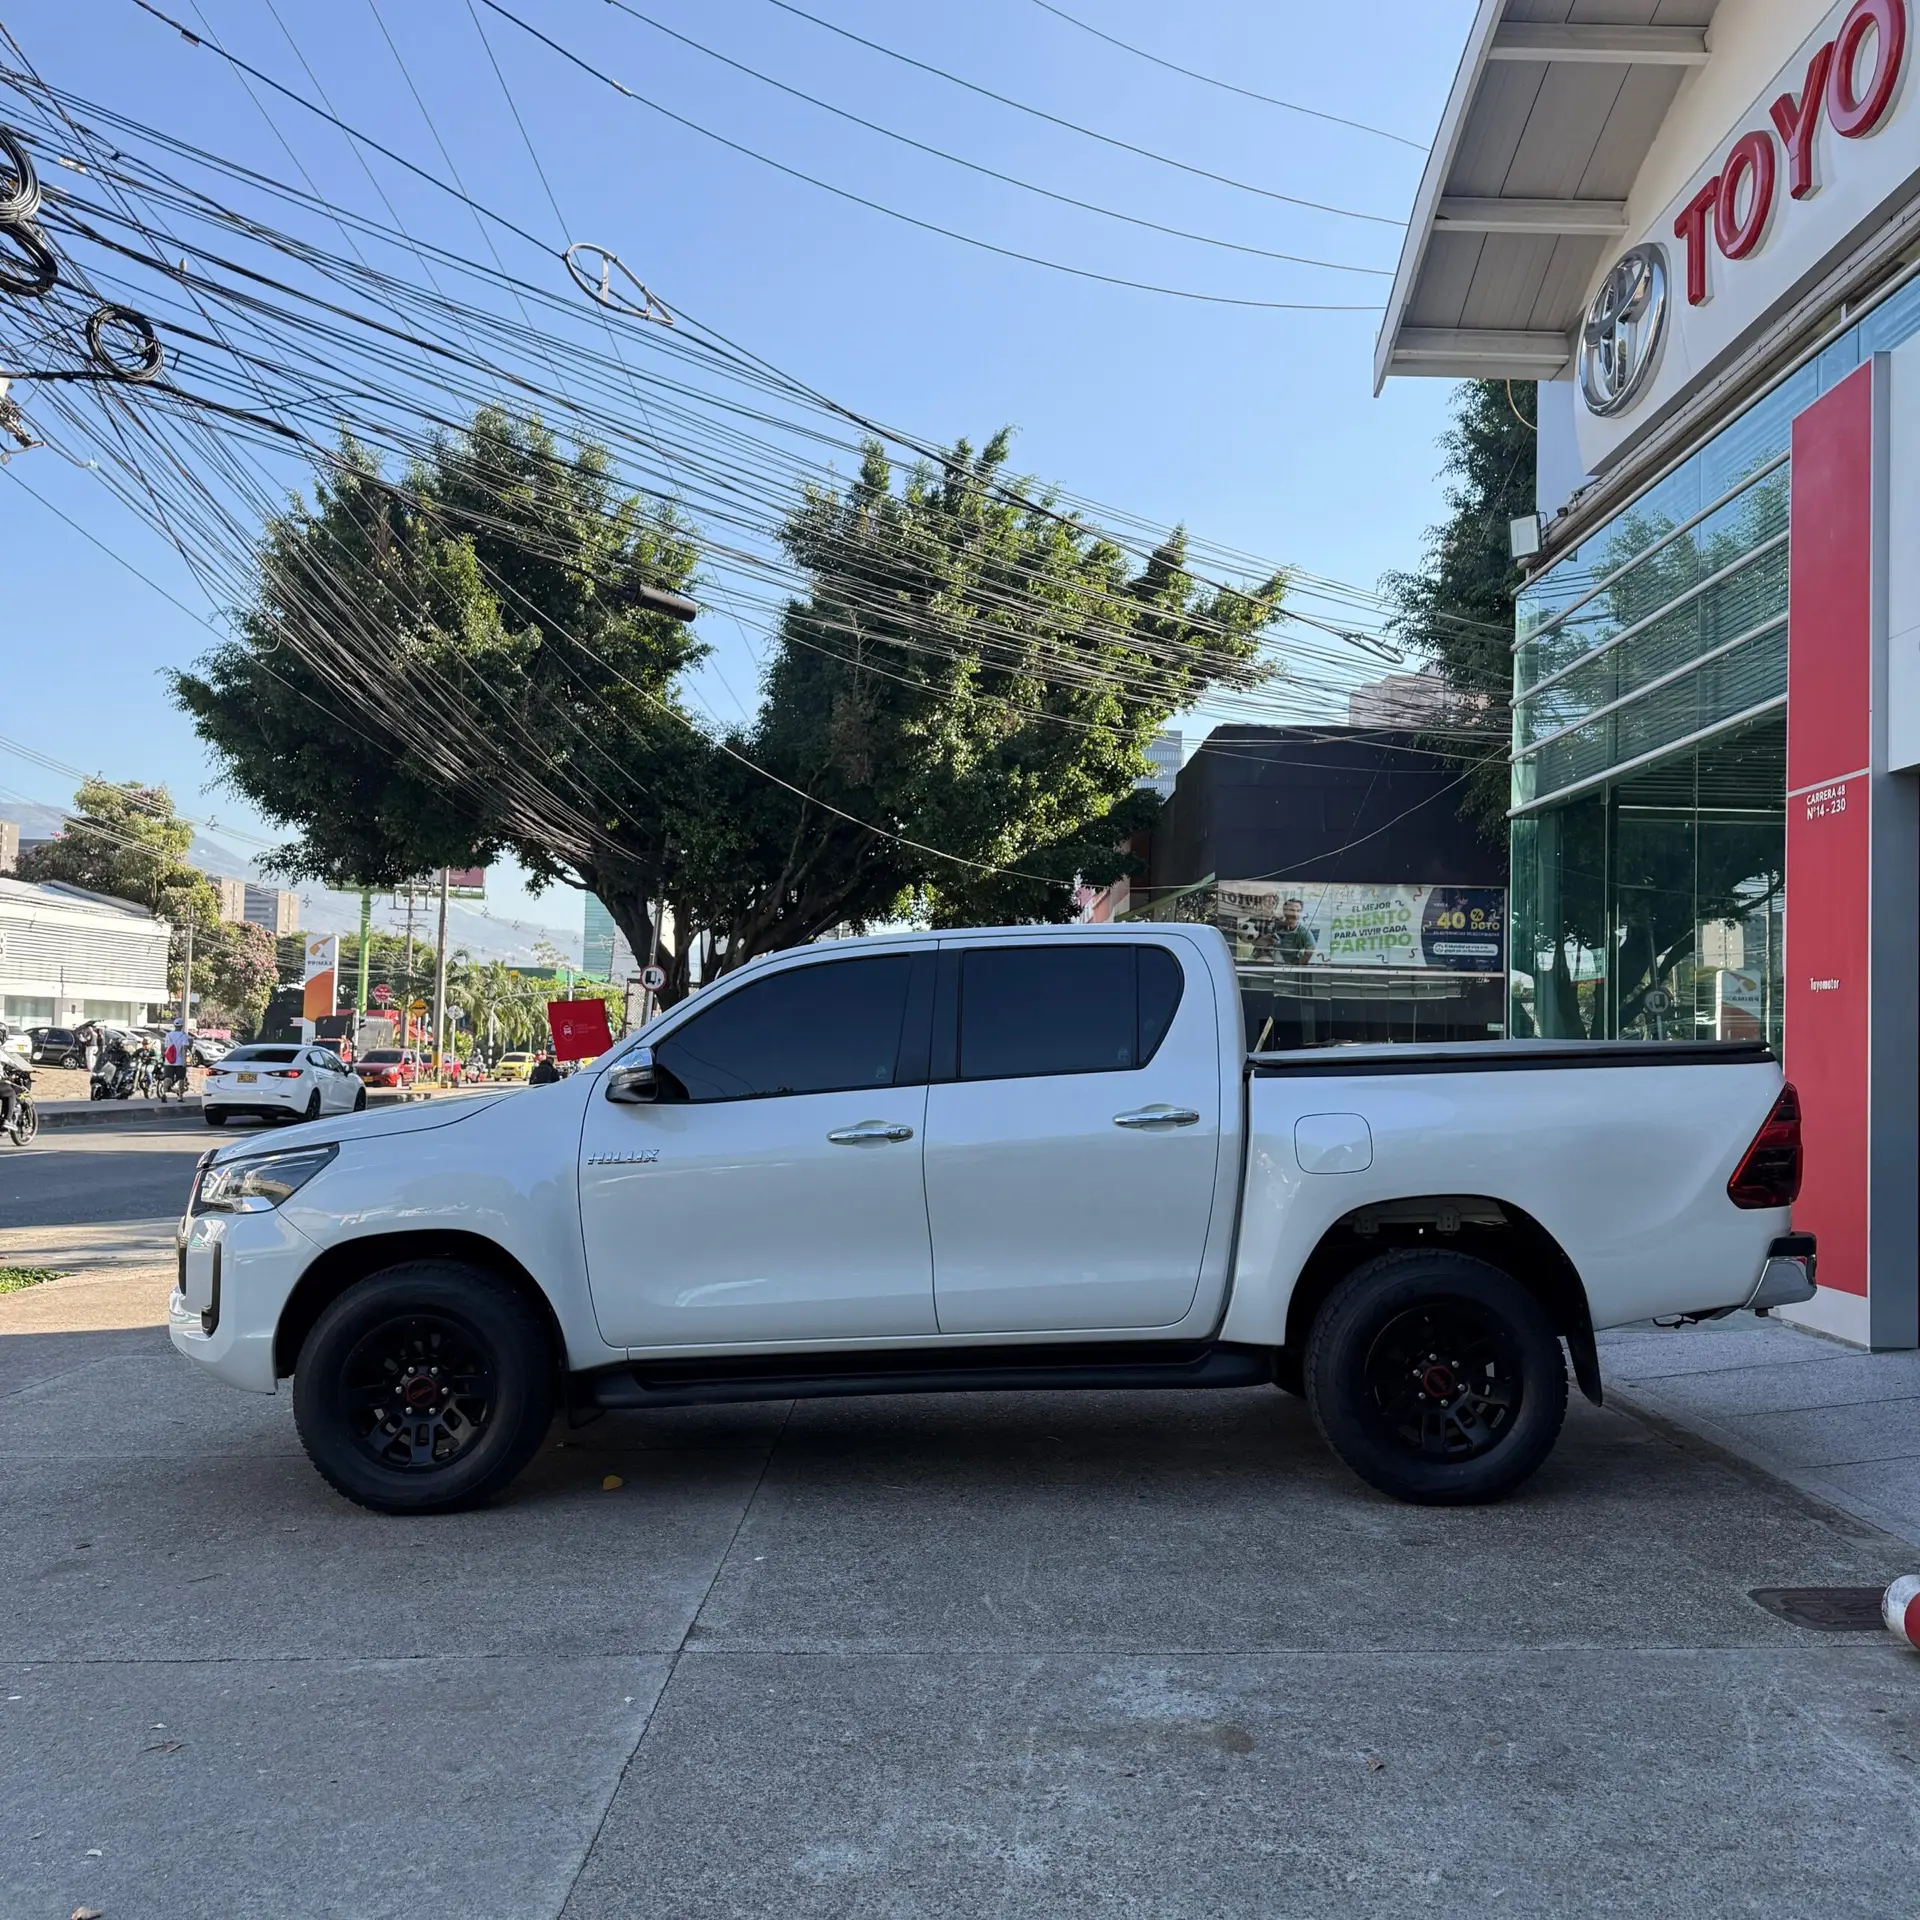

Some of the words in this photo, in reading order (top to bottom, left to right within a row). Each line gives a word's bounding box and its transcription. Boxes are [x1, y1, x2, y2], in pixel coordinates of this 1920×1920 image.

[1674, 0, 1910, 306] TOYO
[1806, 788, 1836, 805] CARRERA
[1837, 784, 1846, 796] 48
[1831, 798, 1846, 814] 230
[1352, 905, 1360, 913] EL
[1362, 901, 1391, 912] MEJOR
[1331, 908, 1412, 930] ASIENTO
[1436, 911, 1466, 930] 40
[1471, 921, 1500, 931] DCTO
[1334, 930, 1357, 939] PARA
[1359, 927, 1381, 937] VIVIR
[1383, 924, 1407, 934] CADA
[1330, 932, 1412, 955] PARTIDO
[587, 1149, 660, 1165] HILUX
